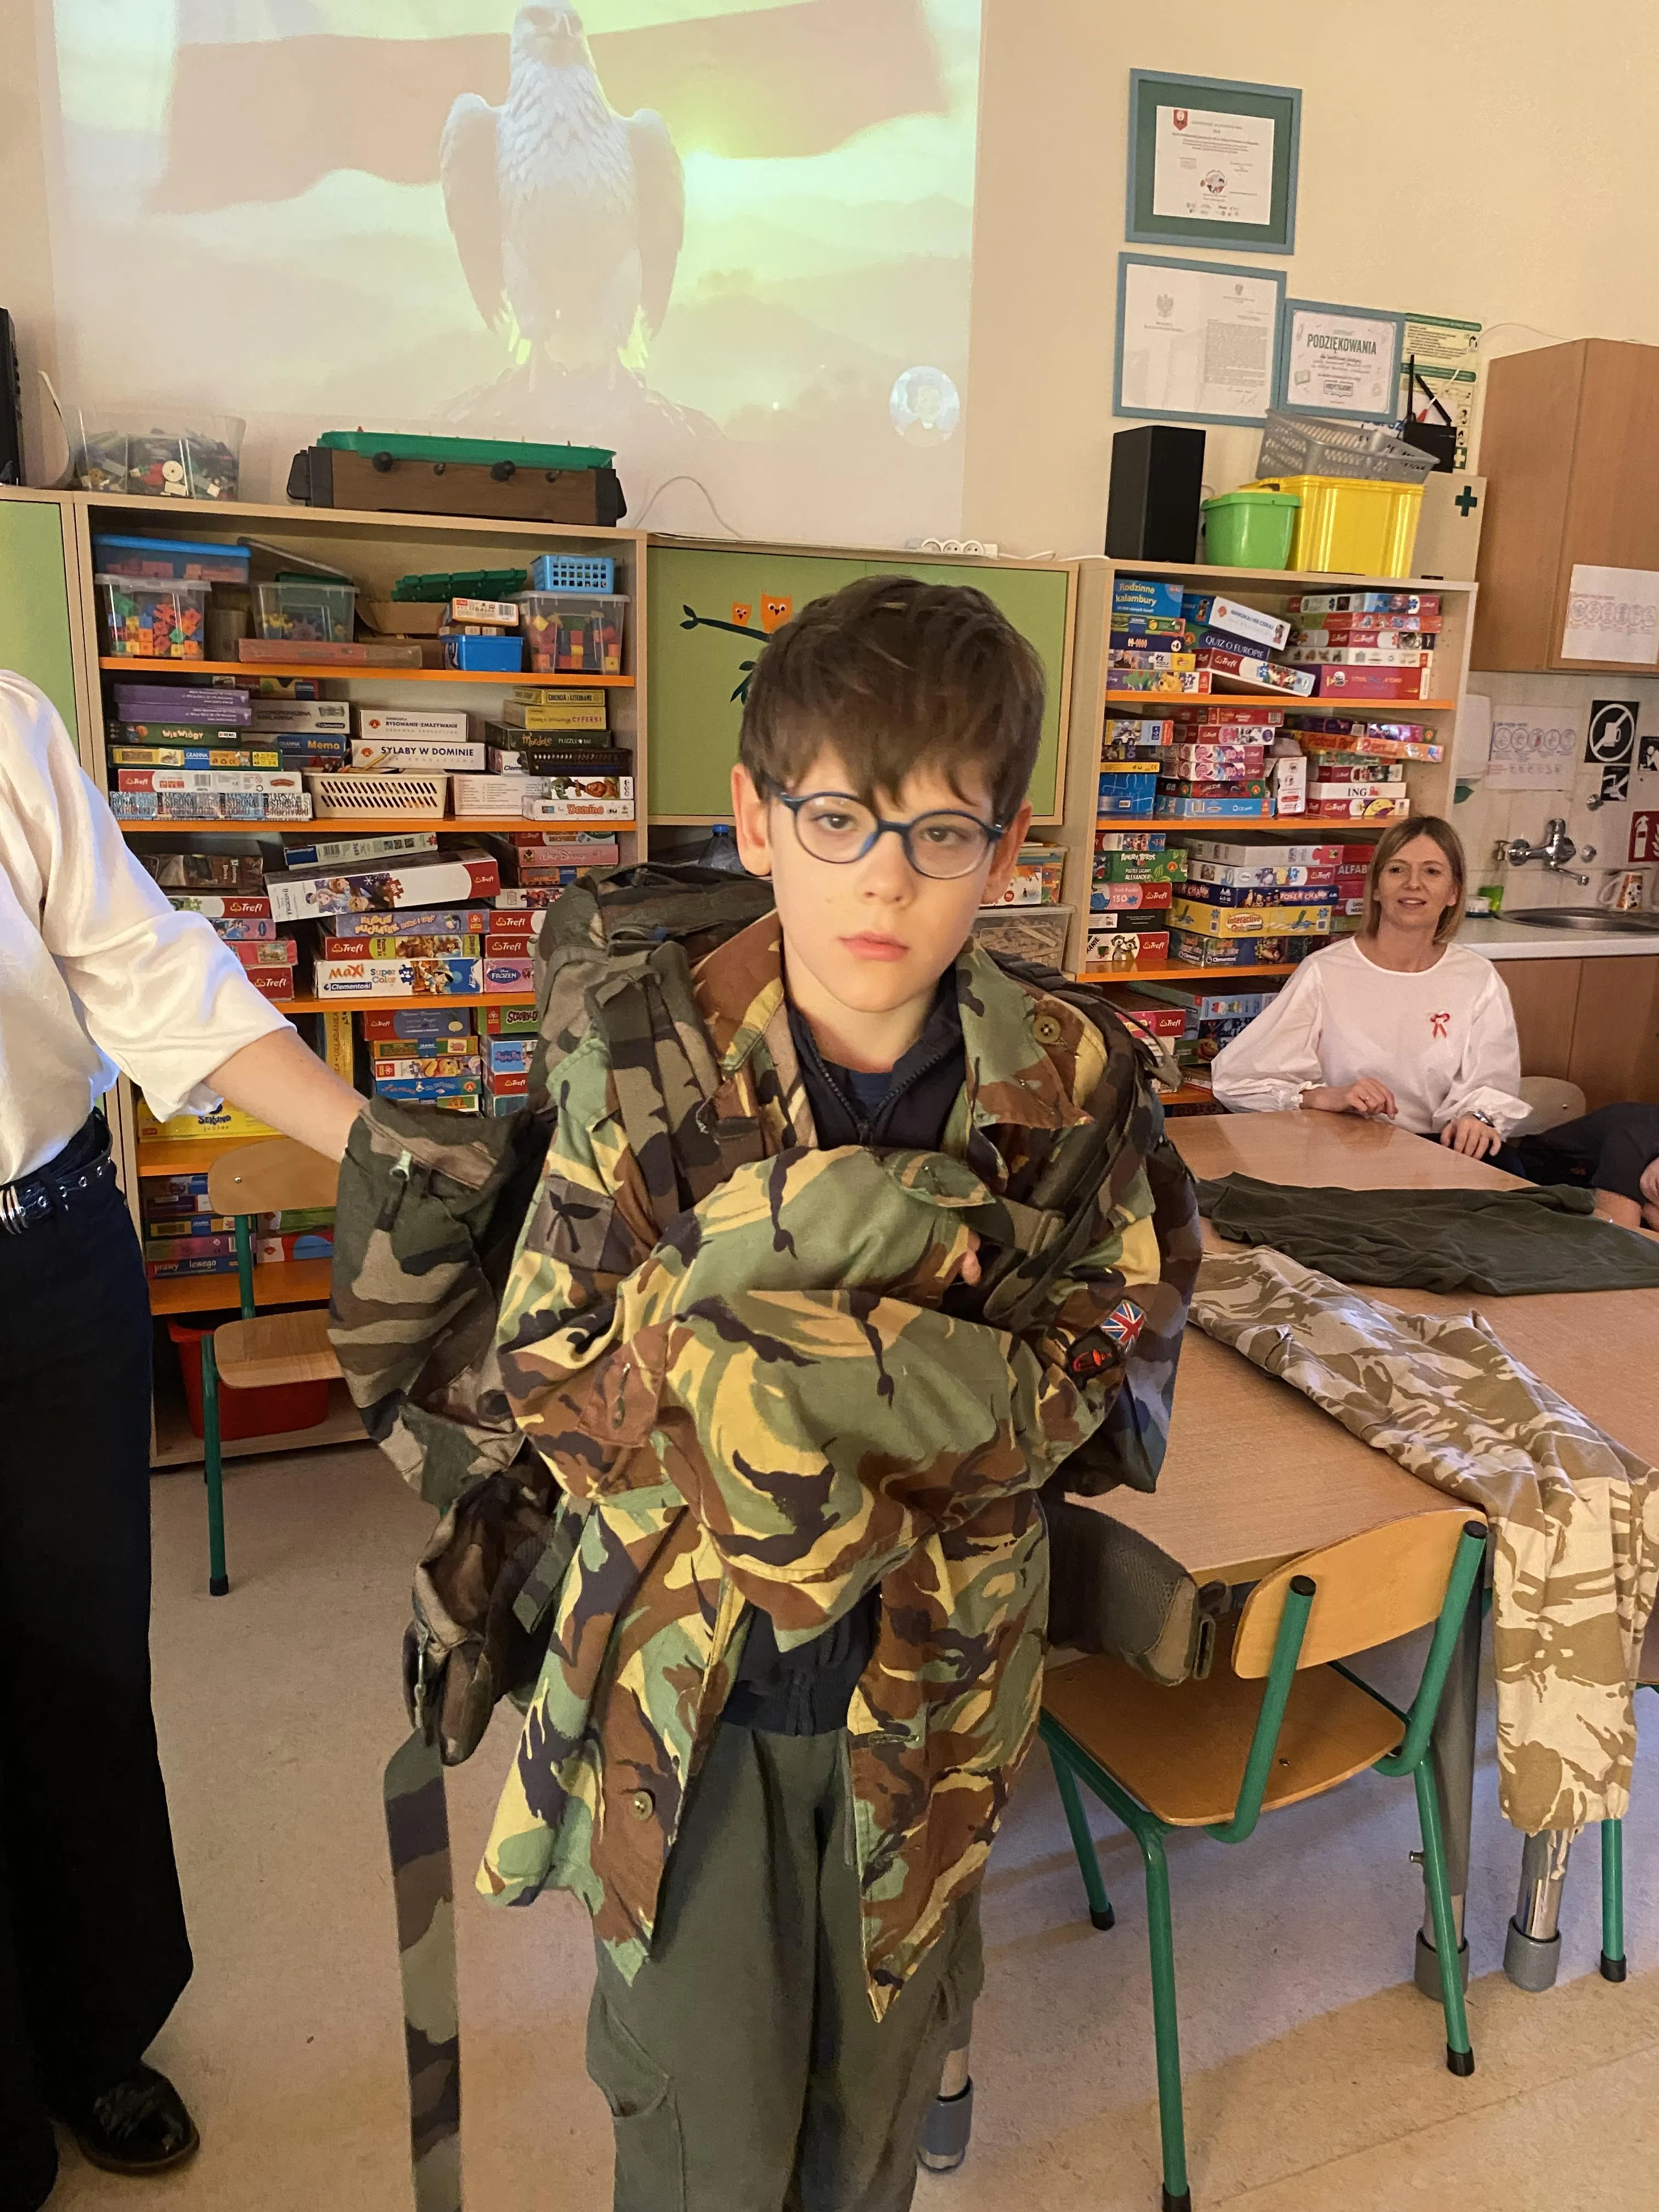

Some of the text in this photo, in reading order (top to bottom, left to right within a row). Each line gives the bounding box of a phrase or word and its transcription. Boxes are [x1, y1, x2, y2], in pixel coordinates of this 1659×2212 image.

[1307, 334, 1376, 355] PODZIĘKOWANIA
[1119, 583, 1155, 594] Rodzinne
[1115, 594, 1157, 607] kalambury
[1205, 636, 1225, 648] QUIZ
[1234, 644, 1265, 659] EUROPIE
[307, 740, 340, 750] Memo
[381, 746, 416, 754] SYLABY
[432, 748, 474, 756] DOMINIE
[1347, 788, 1367, 797] ING
[1280, 891, 1302, 901] POKER
[241, 903, 262, 912] Trefl
[506, 917, 526, 927] Trefl
[343, 943, 363, 953] Trefl
[503, 942, 522, 951] Trefl
[1151, 941, 1165, 950] Trefl
[370, 968, 396, 977] Super
[266, 978, 287, 988] Trefl
[372, 975, 396, 984] Color
[331, 983, 372, 991] Clementoni
[1167, 1019, 1181, 1028] Trefl
[154, 1259, 217, 1274] prawy lewego
